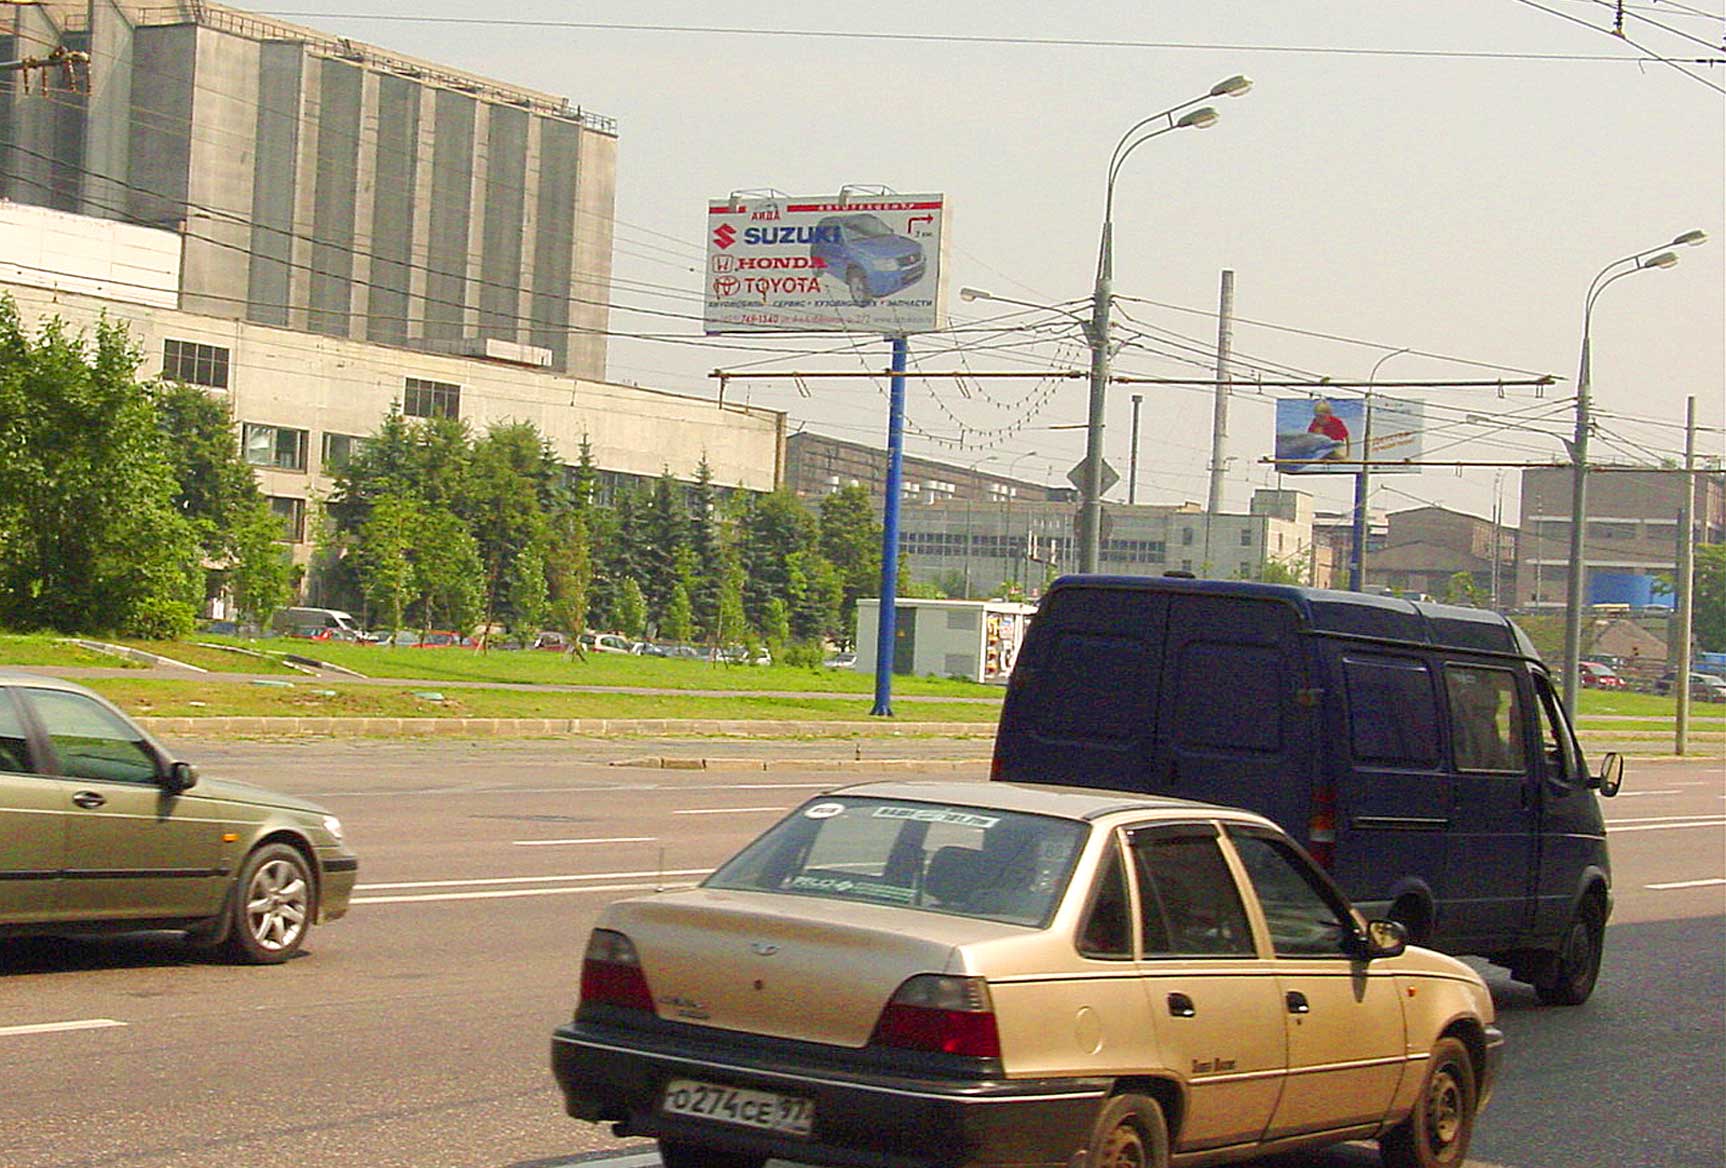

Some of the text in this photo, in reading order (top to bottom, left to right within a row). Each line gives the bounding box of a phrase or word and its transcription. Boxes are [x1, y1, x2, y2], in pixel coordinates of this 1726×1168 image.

[744, 226, 841, 245] SUZUKI
[738, 257, 828, 269] HONDA
[744, 277, 821, 293] TOYOTA
